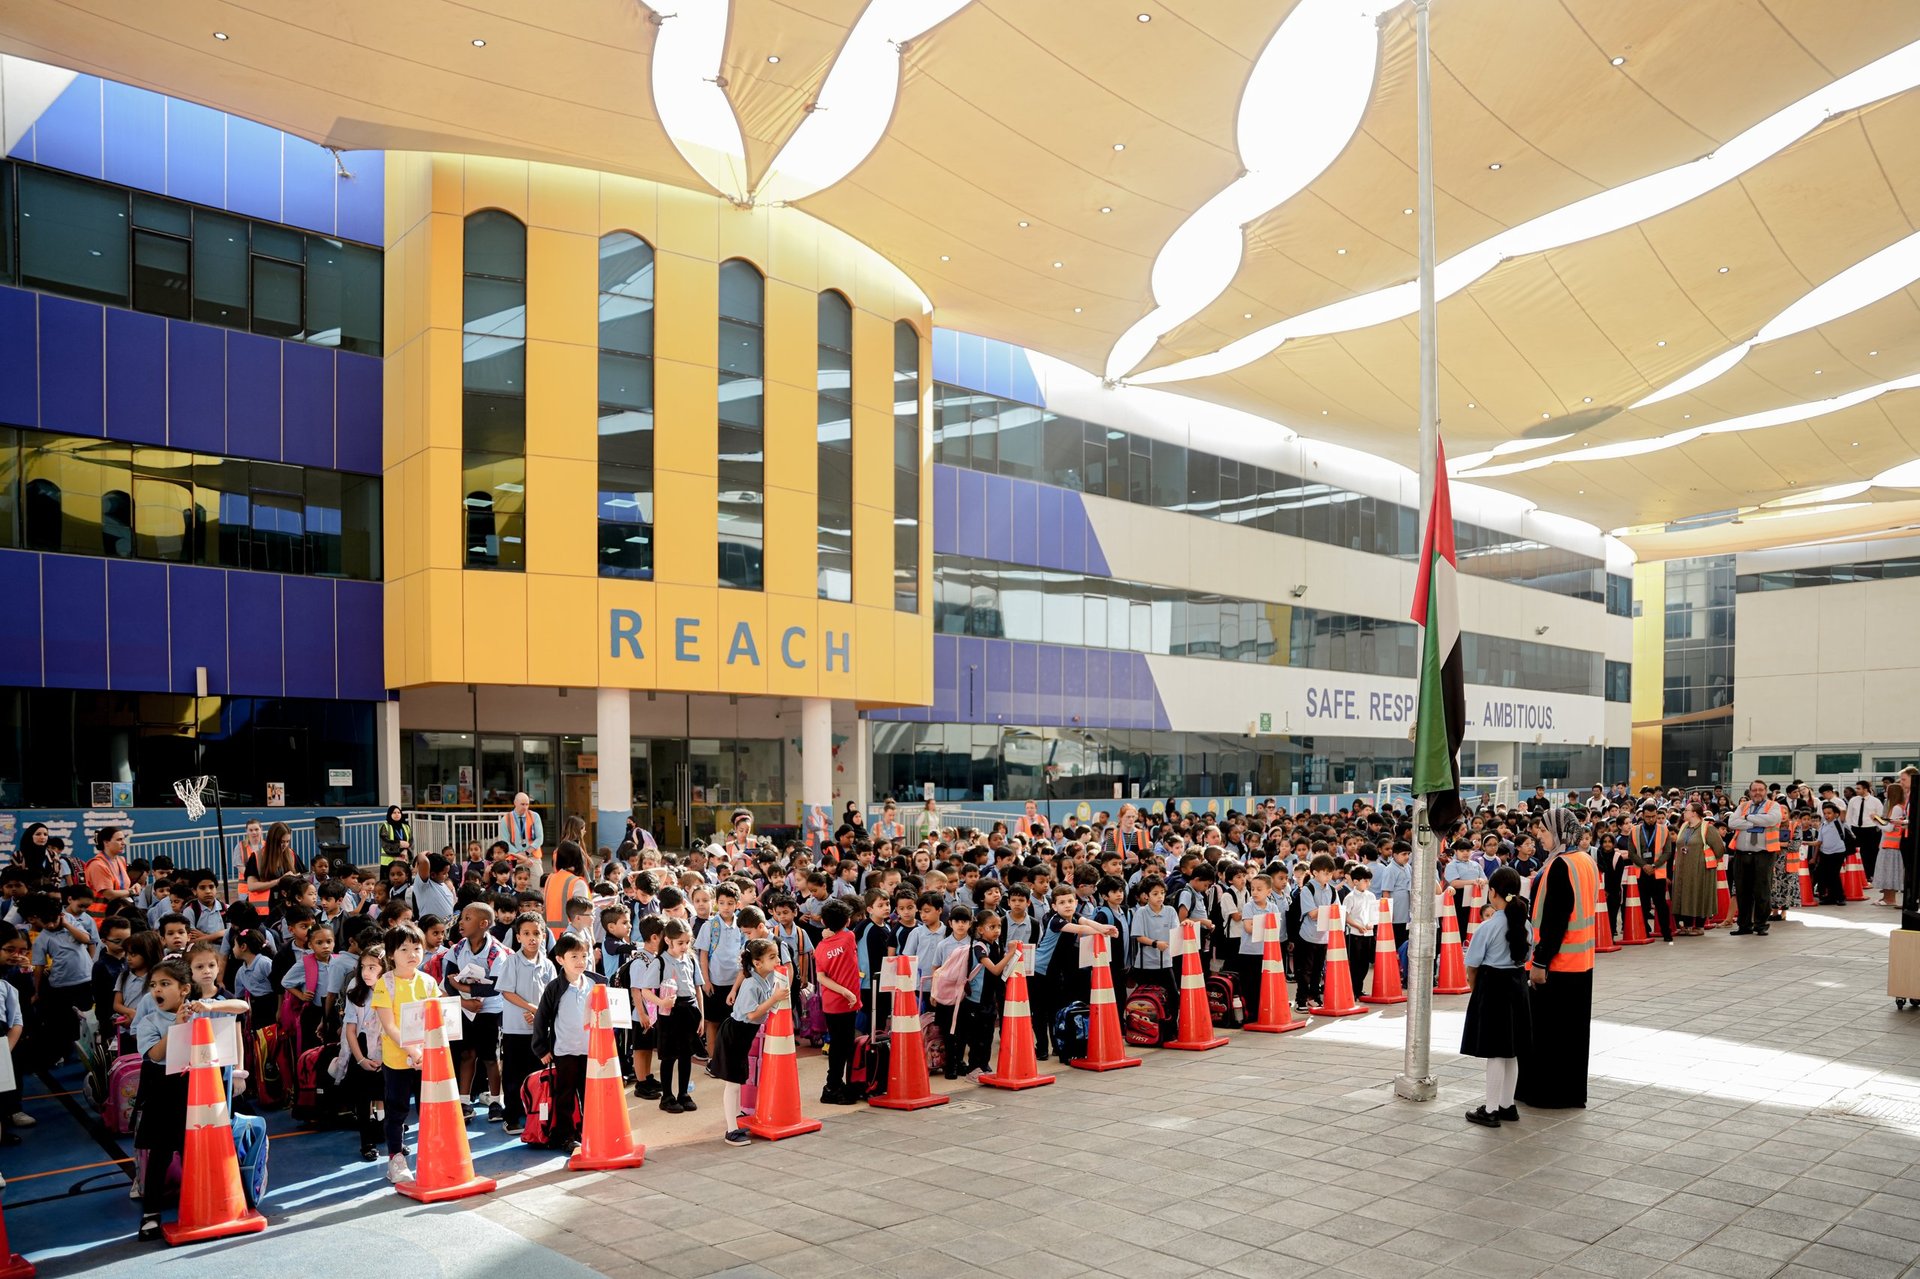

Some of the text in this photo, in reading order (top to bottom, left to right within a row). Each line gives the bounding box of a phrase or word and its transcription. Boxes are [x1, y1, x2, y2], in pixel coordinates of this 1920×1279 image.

[610, 608, 850, 673] REACH
[1306, 687, 1360, 720] SAFE.
[1483, 701, 1556, 730] AMBITIOUS.
[826, 946, 844, 959] SUN
